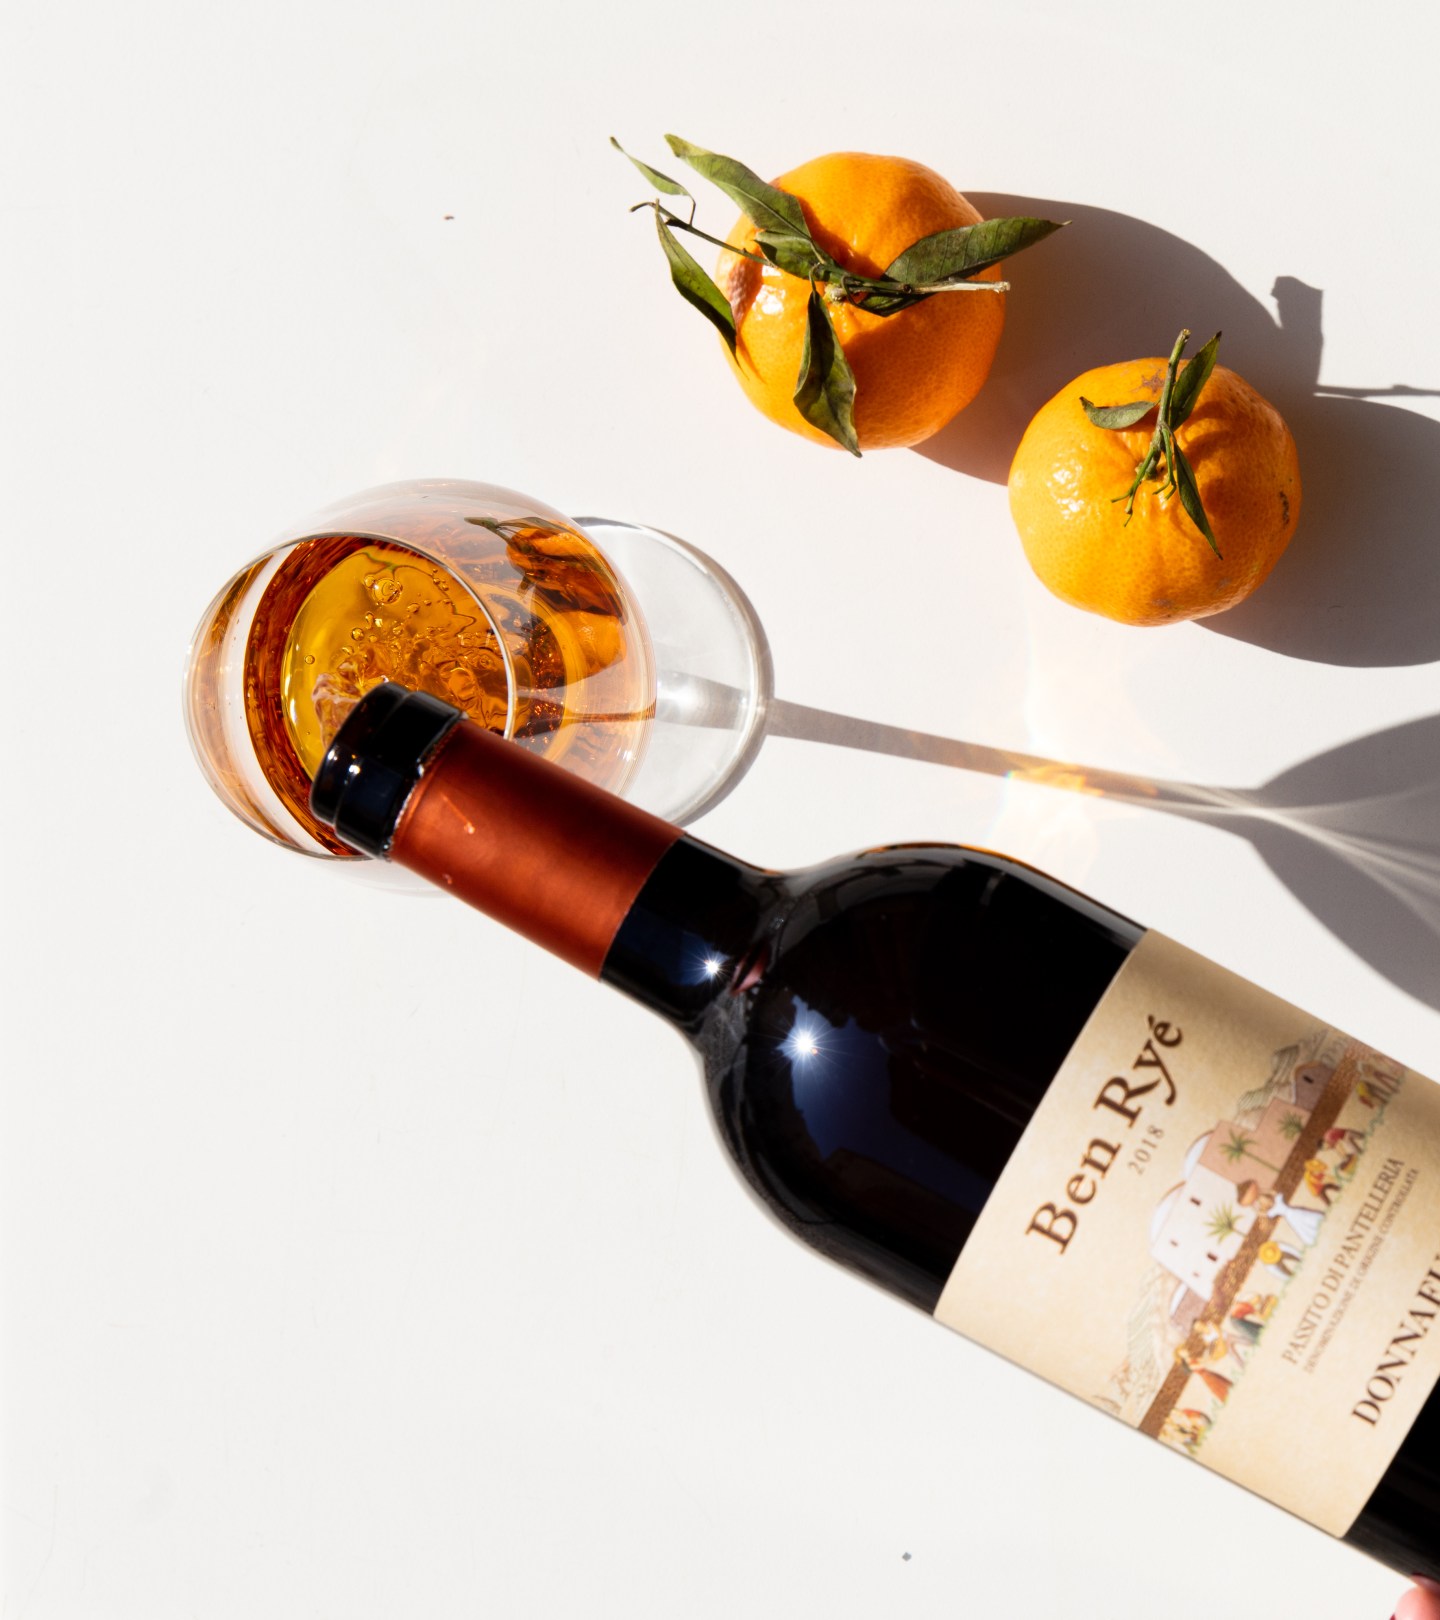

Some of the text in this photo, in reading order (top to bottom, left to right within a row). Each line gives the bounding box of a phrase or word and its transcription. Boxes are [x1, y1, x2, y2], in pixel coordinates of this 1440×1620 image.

[1025, 1014, 1183, 1255] Ben Ryé
[1128, 1124, 1164, 1175] 2018
[1282, 1157, 1405, 1364] PASSITO DI PANTELLERIA
